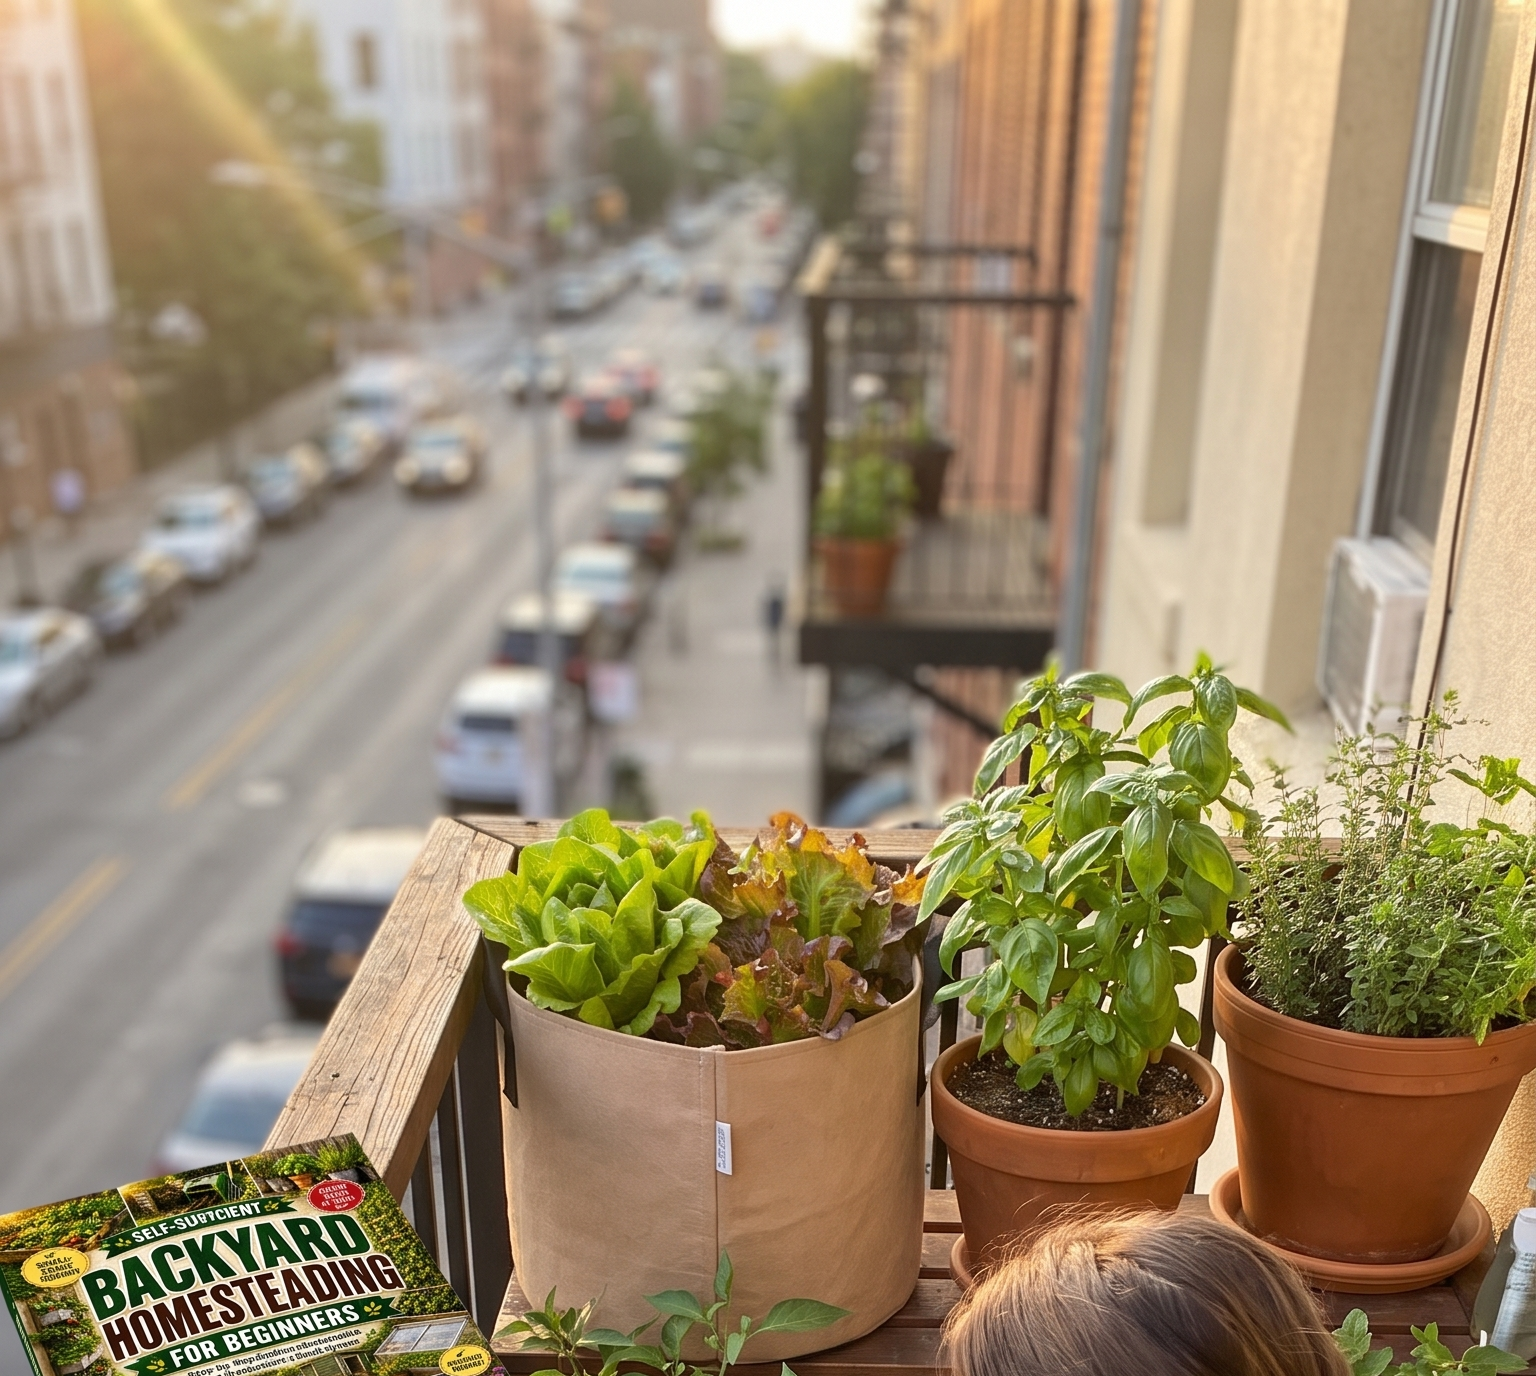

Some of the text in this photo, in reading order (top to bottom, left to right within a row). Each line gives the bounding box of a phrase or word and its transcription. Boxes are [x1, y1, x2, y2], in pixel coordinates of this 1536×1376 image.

[81, 1214, 371, 1321] BACKYARD
[102, 1255, 404, 1361] HOMESTEADING
[170, 1338, 220, 1368] FOR
[222, 1304, 360, 1353] BEGINNERS
